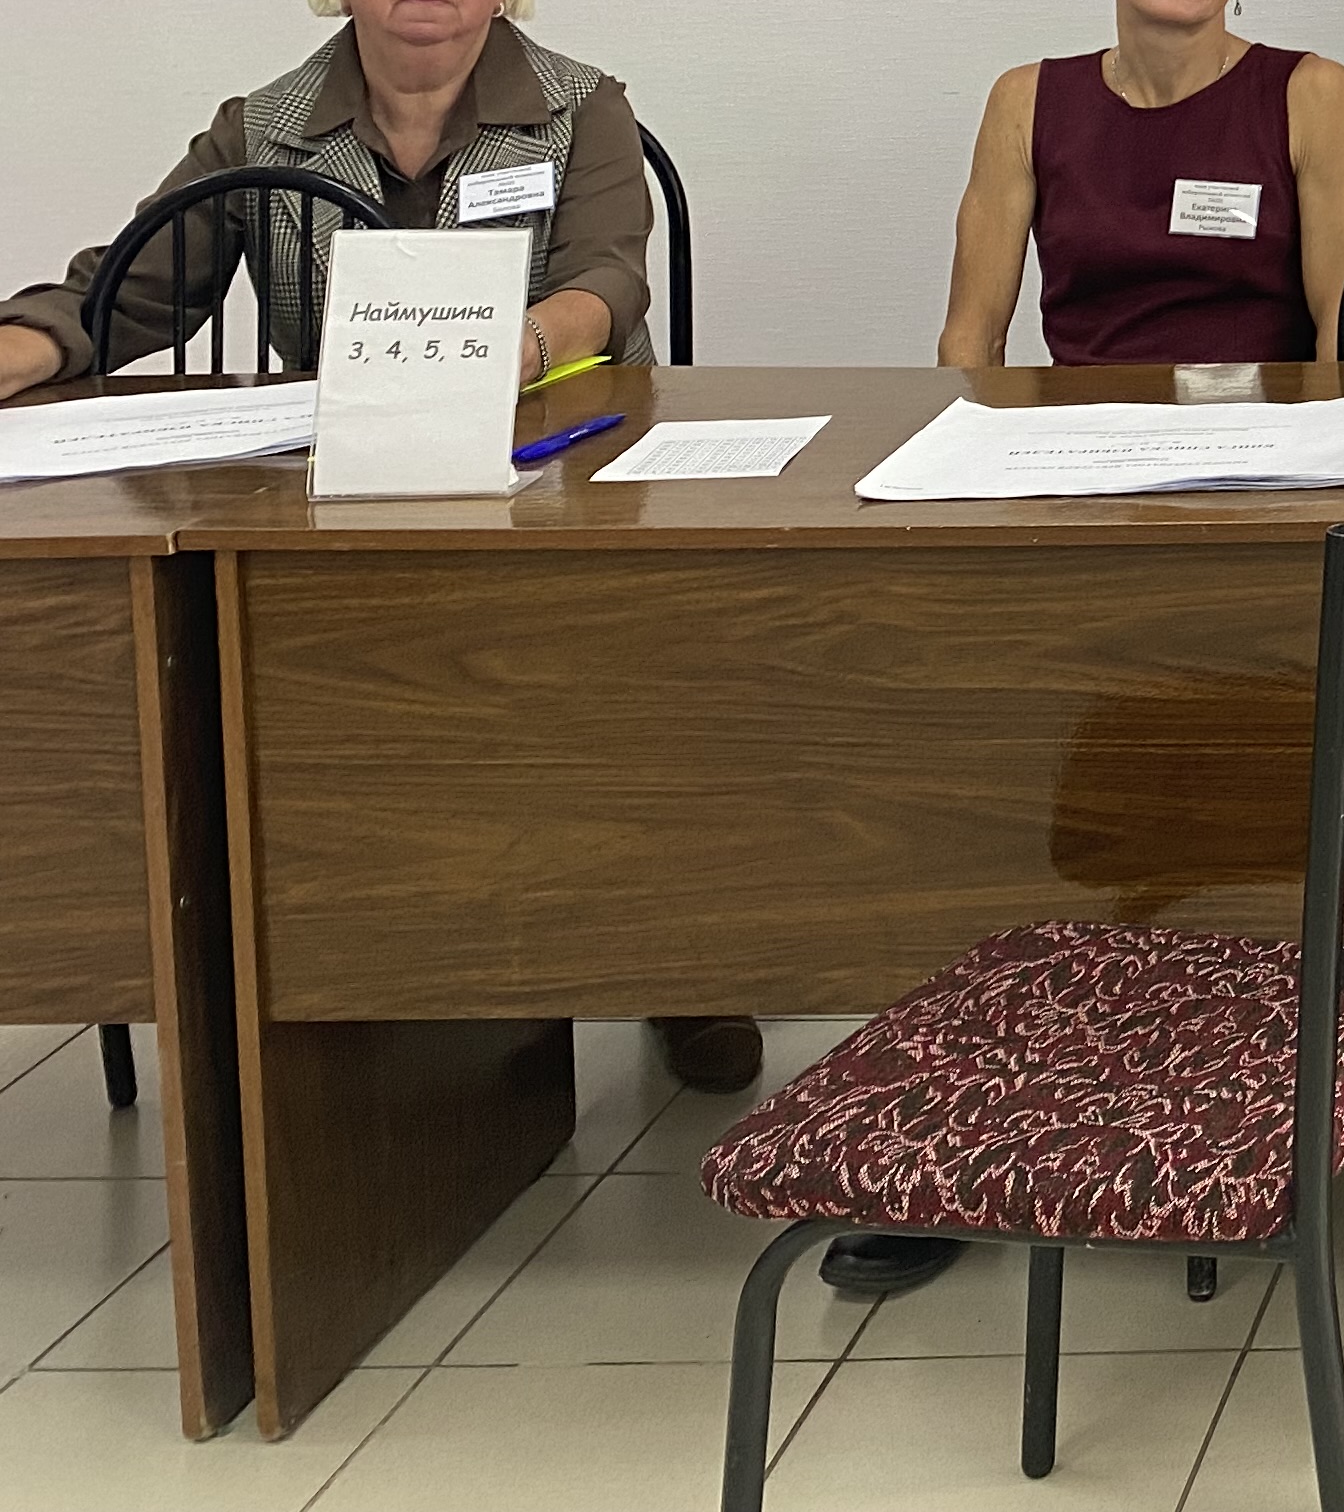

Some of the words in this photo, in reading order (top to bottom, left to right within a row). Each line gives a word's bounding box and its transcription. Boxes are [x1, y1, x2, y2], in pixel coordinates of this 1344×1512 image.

[468, 191, 545, 209] Александровна
[350, 301, 495, 327] Наймушина
[348, 341, 371, 364] 3,
[385, 340, 408, 363] 4,
[423, 339, 446, 363] 5,
[460, 339, 489, 359] 5а
